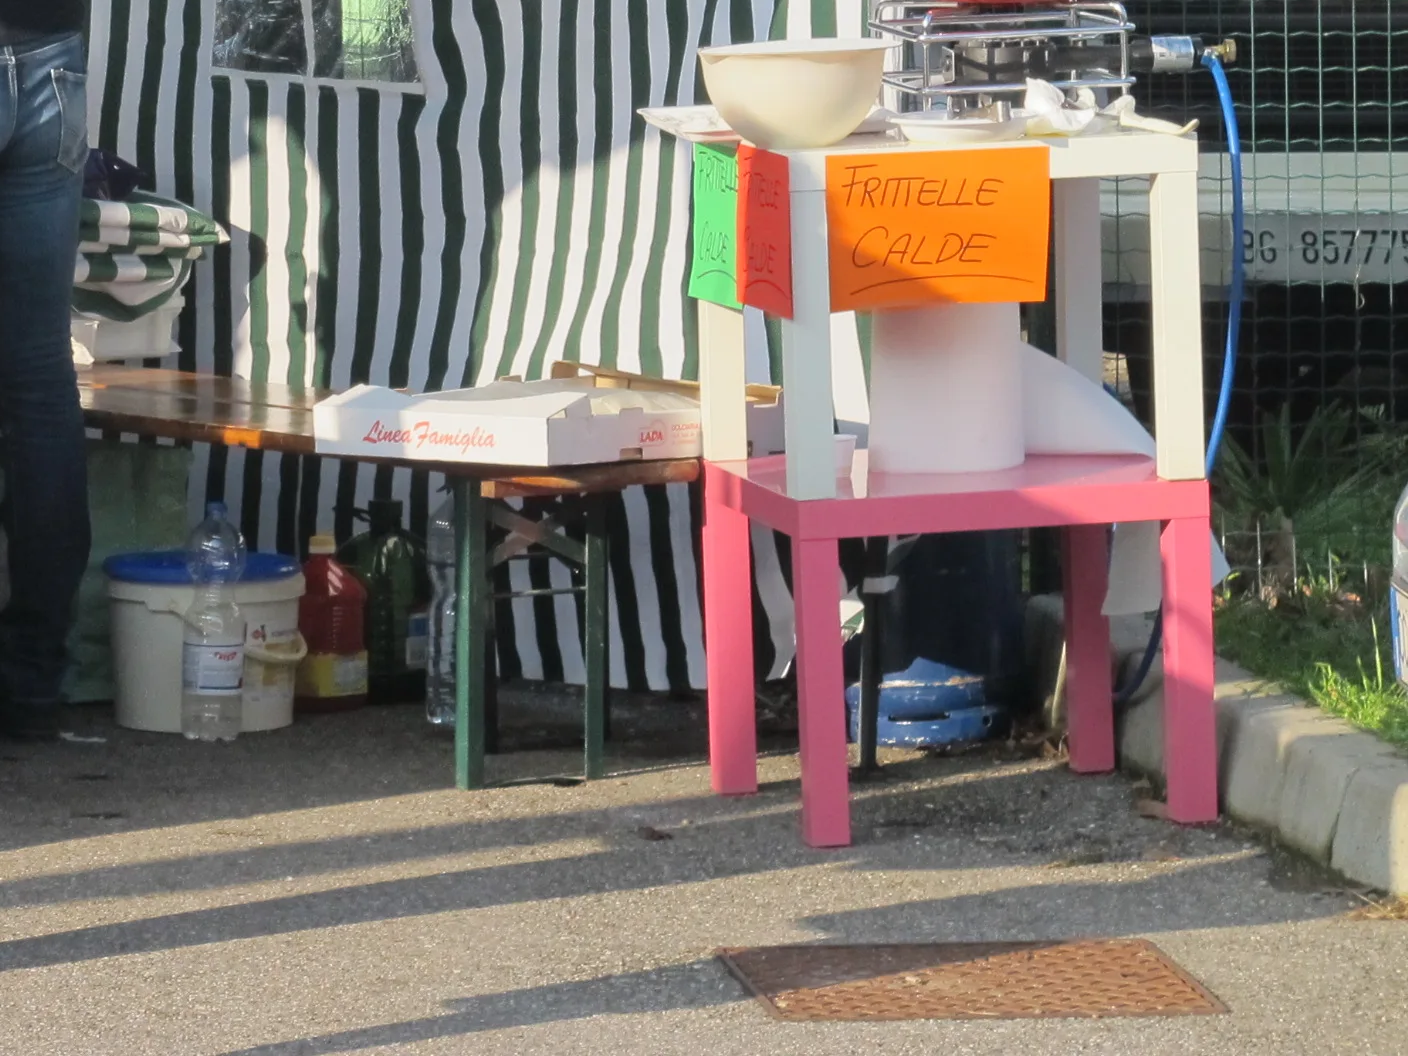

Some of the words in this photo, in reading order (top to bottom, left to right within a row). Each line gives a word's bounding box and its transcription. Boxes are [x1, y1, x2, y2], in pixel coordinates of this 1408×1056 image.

[699, 221, 729, 263] CALDE
[852, 226, 997, 268] CALDE
[363, 420, 412, 443] Linea
[413, 421, 496, 455] Famiglia
[639, 431, 663, 443] LADA
